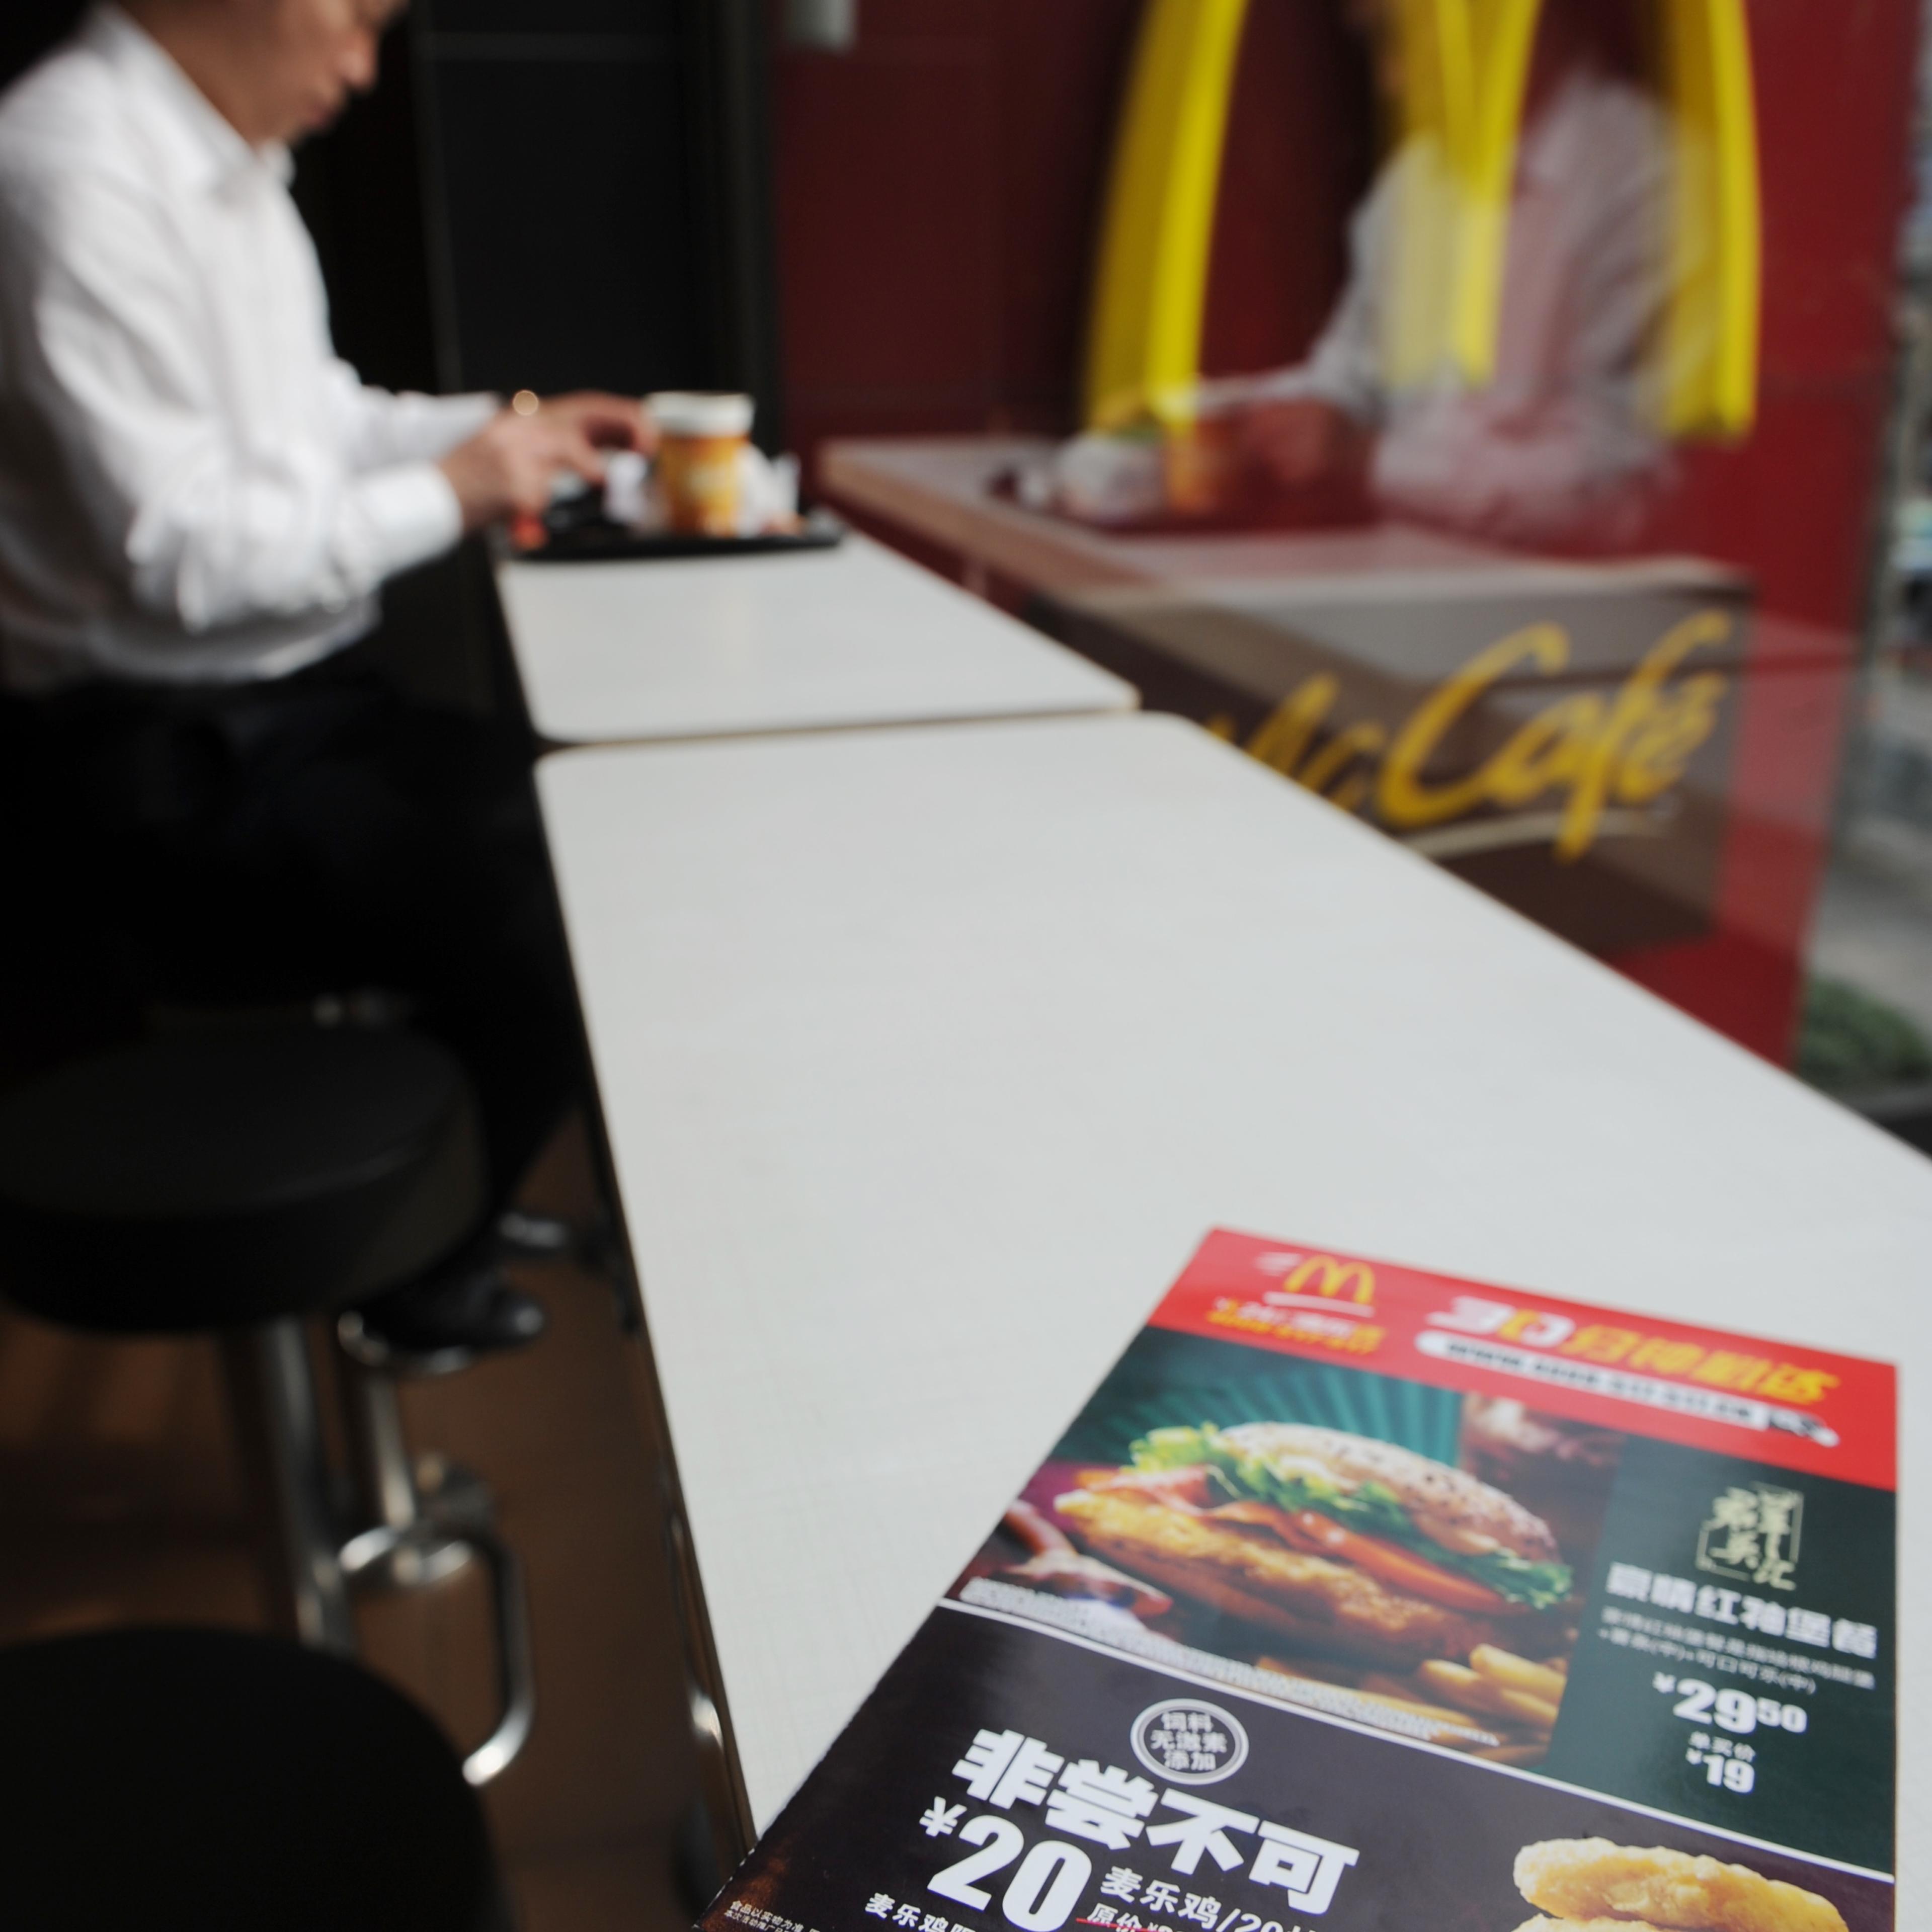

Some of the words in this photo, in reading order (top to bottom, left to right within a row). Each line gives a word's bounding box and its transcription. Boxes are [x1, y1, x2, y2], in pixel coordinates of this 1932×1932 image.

[1150, 1729, 1227, 1753] 无激素
[1163, 1751, 1216, 1770] 添加
[1685, 1747, 1755, 1794] ¥19
[952, 1729, 1360, 1915] 非尝不可
[919, 1796, 1092, 1932] ¥20
